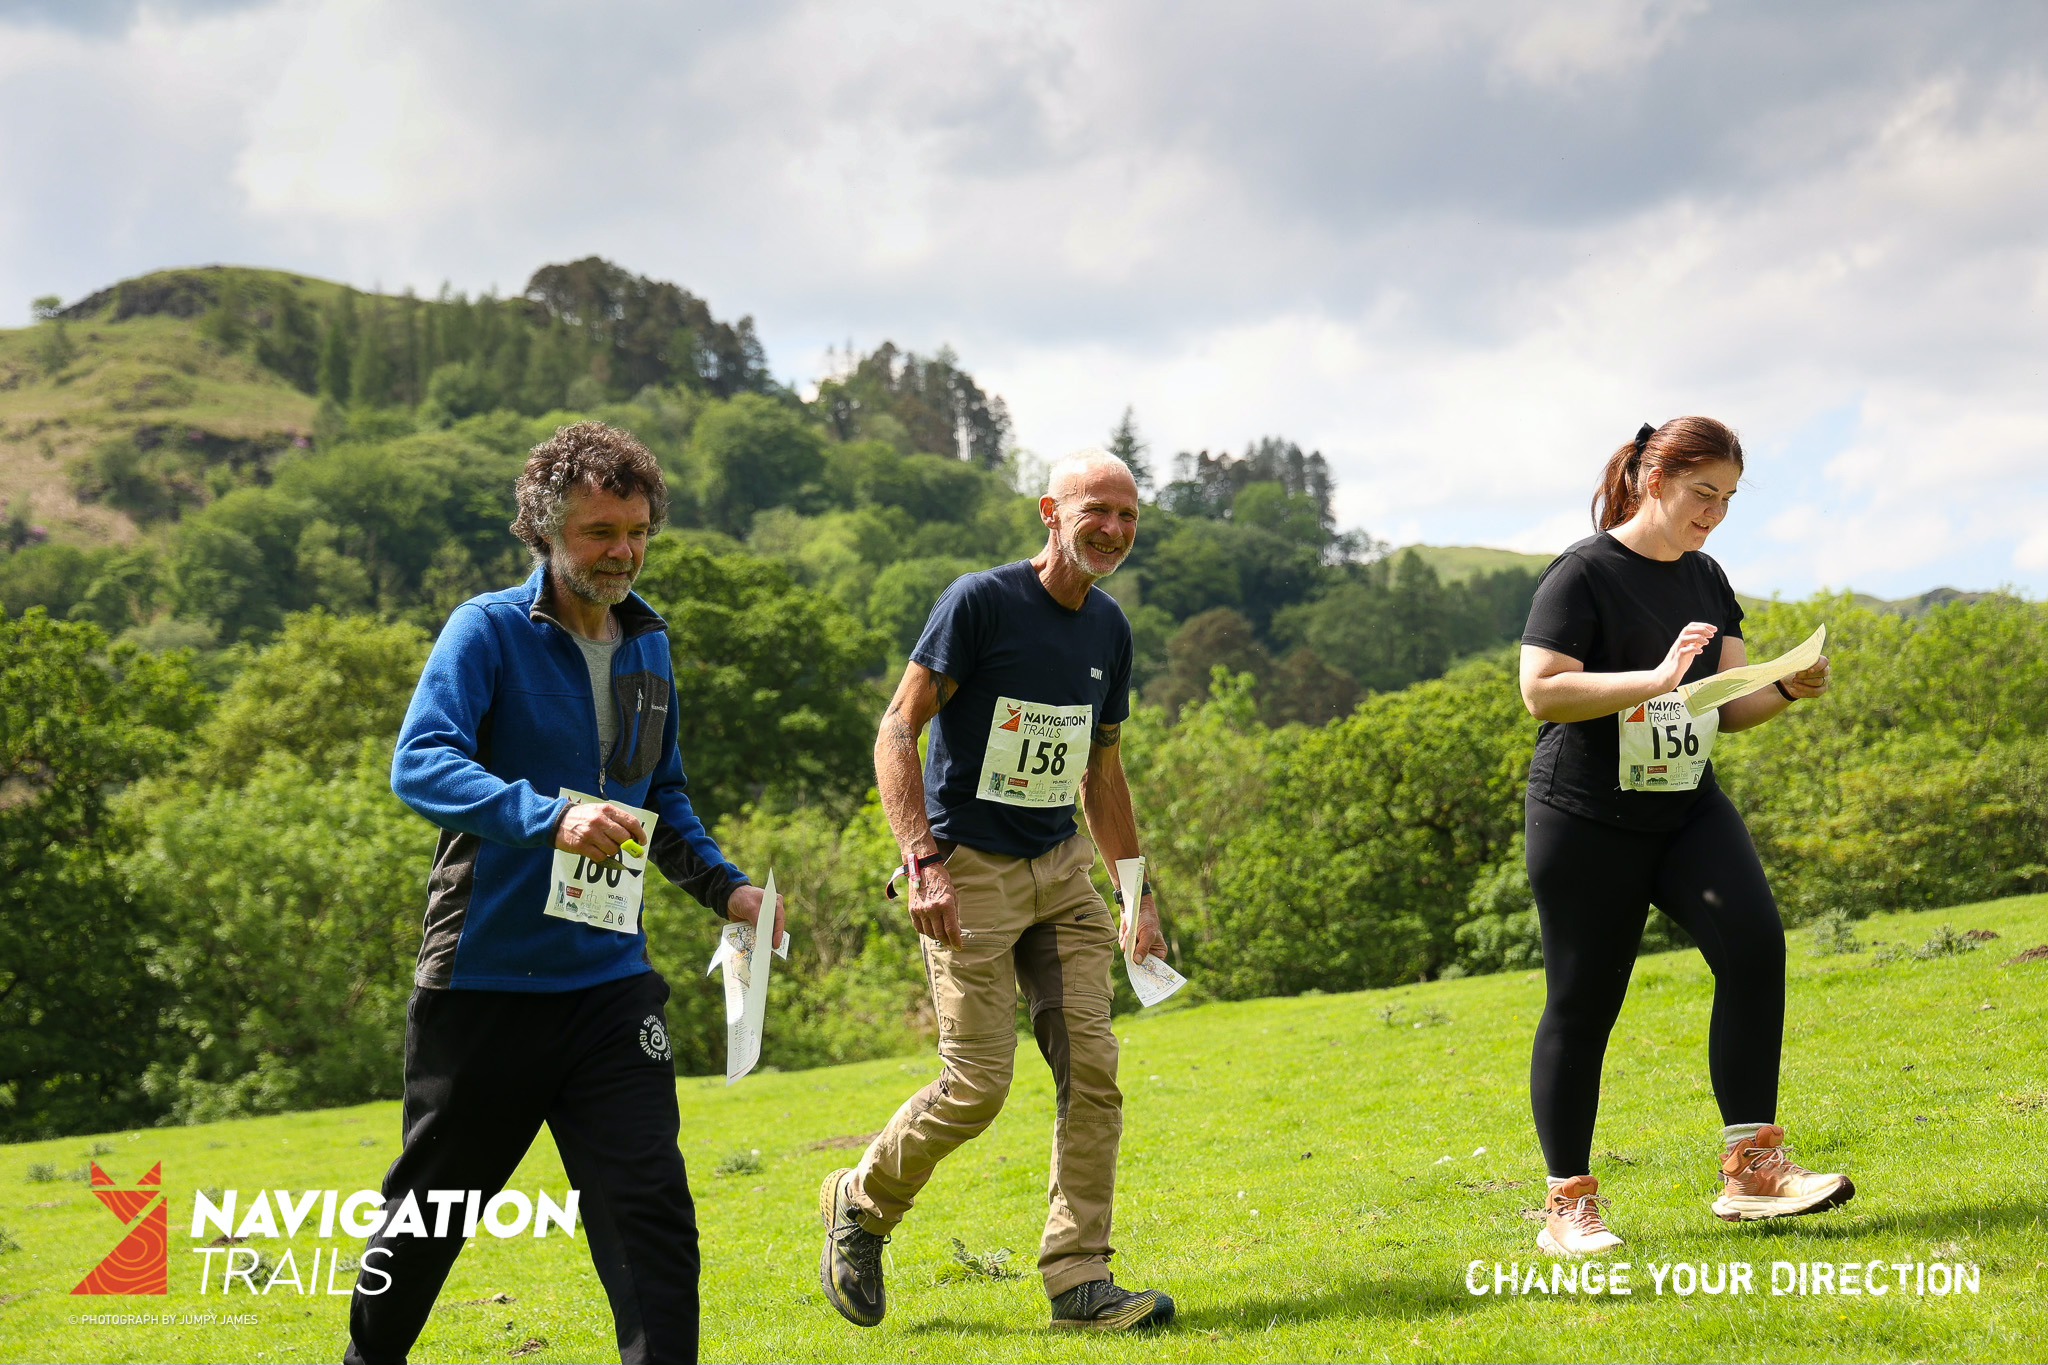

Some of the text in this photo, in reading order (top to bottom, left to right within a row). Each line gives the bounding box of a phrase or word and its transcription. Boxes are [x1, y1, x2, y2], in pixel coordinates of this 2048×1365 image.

[1648, 701, 1684, 712] NAVIG
[1024, 712, 1087, 727] NAVIGATION
[1648, 710, 1681, 723] TRAILS
[1023, 724, 1062, 739] TRAILS
[1652, 723, 1699, 760] 156
[1017, 739, 1068, 776] 158
[639, 1028, 662, 1061] AGAINST
